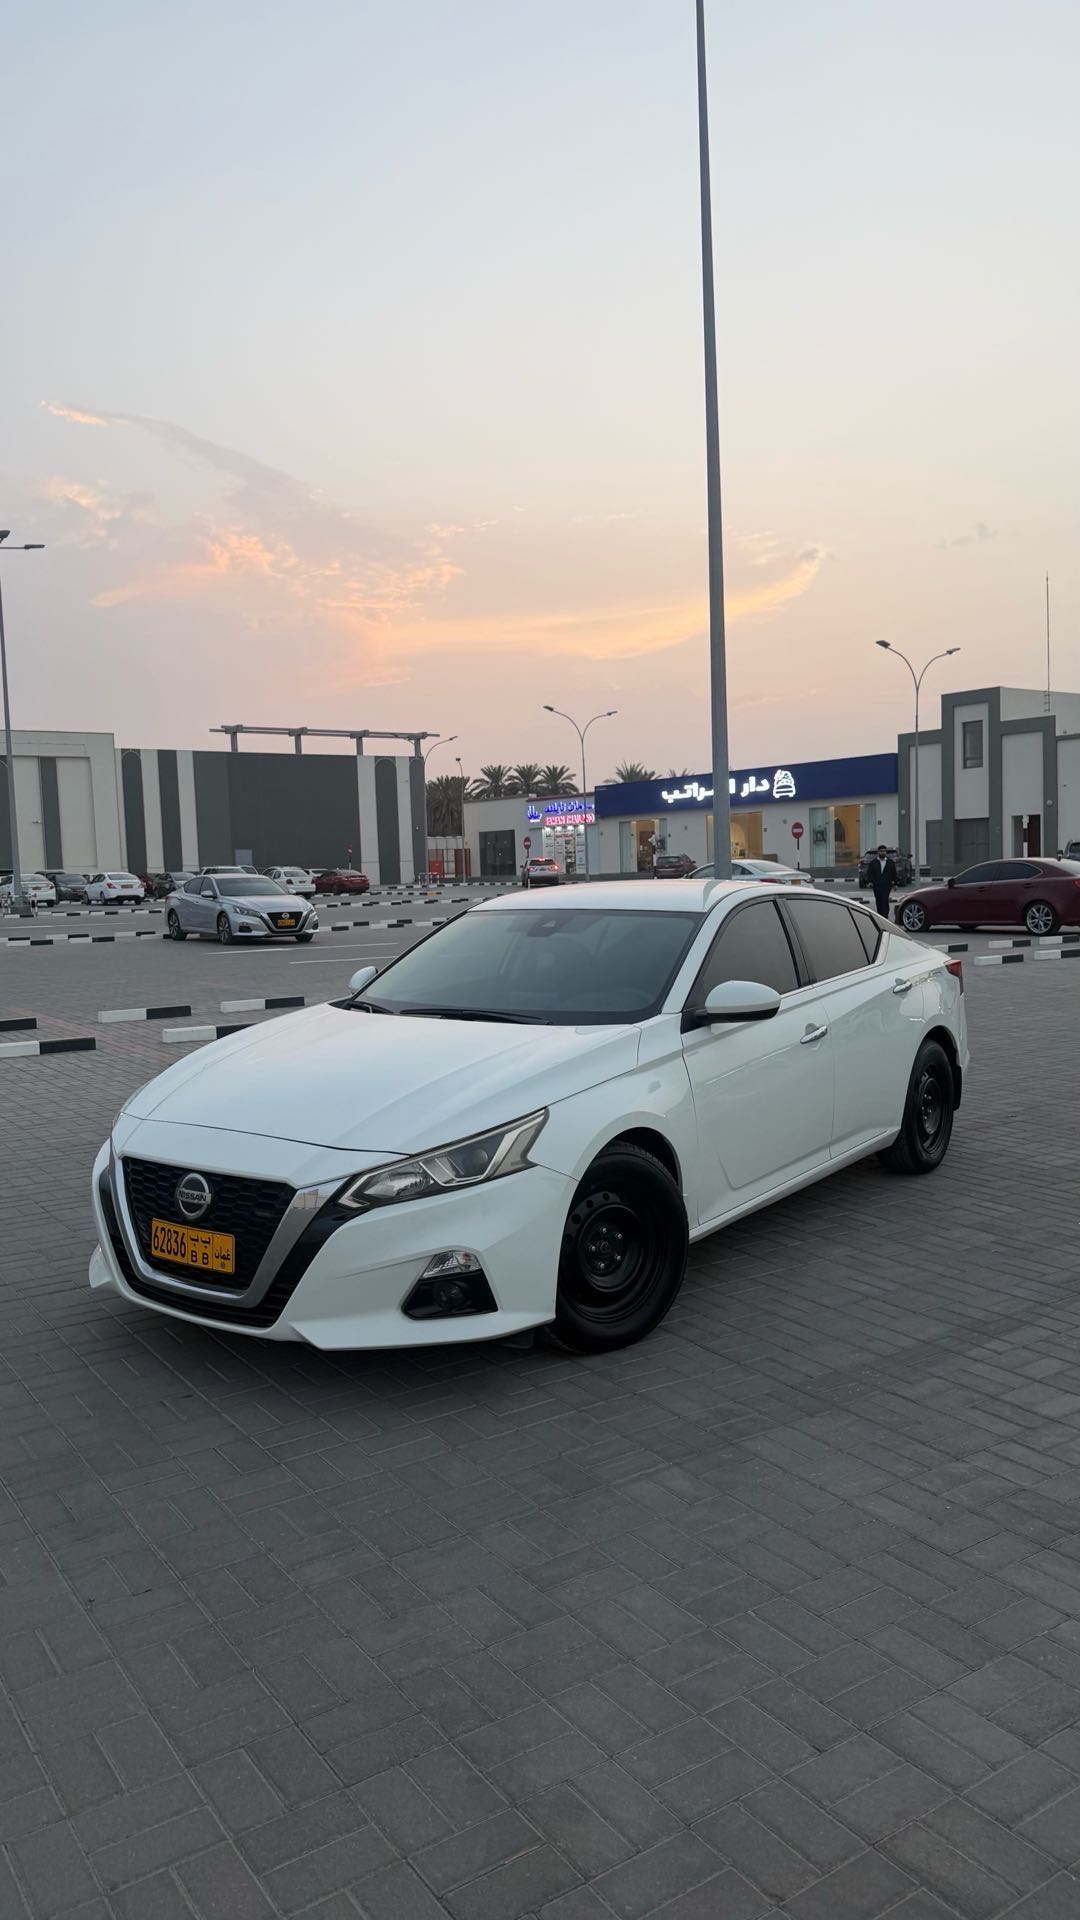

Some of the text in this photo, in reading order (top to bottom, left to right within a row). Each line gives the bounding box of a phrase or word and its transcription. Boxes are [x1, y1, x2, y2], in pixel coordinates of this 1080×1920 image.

[661, 776, 770, 803] دار اراتب
[178, 1191, 207, 1202] NISSAN
[153, 1226, 186, 1258] 62836
